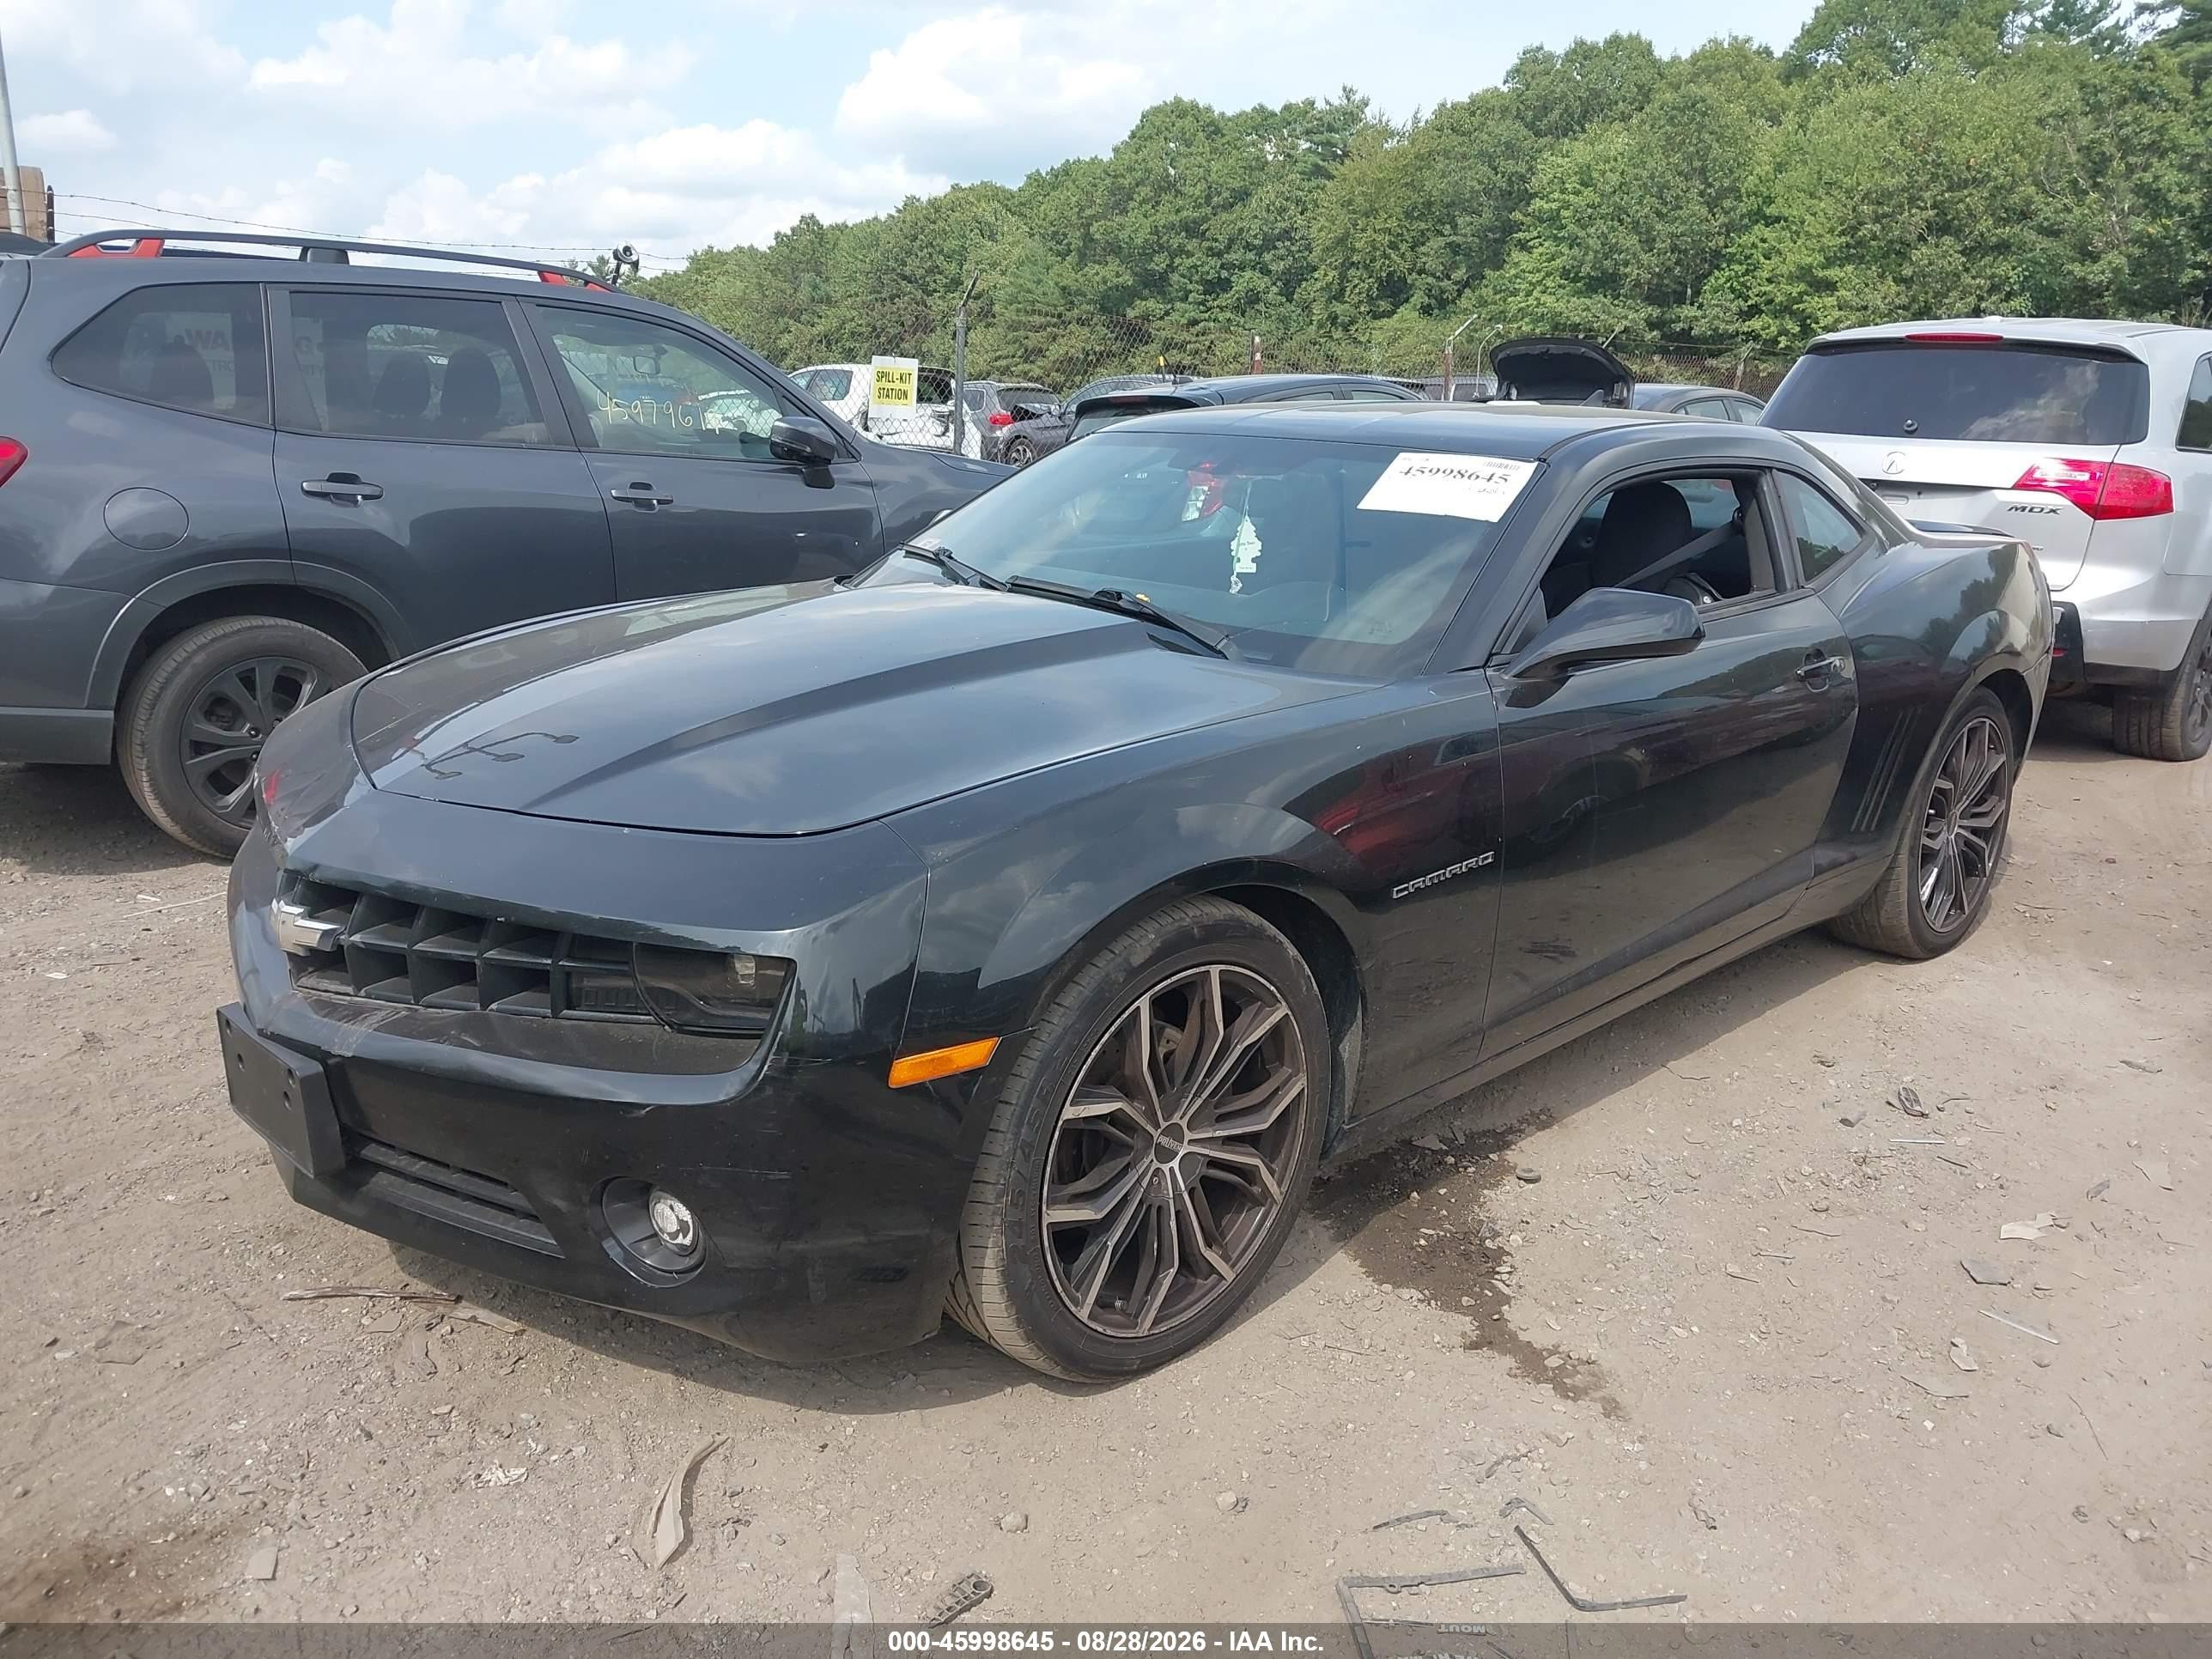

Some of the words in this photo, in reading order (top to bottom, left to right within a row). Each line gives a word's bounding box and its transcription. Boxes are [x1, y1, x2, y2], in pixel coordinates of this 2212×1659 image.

[876, 370, 912, 385] SPILL-KIT
[877, 386, 908, 401] STATION
[1399, 465, 1512, 484] 45998645
[2007, 505, 2063, 515] MDX
[1392, 851, 1495, 899] CAMARO
